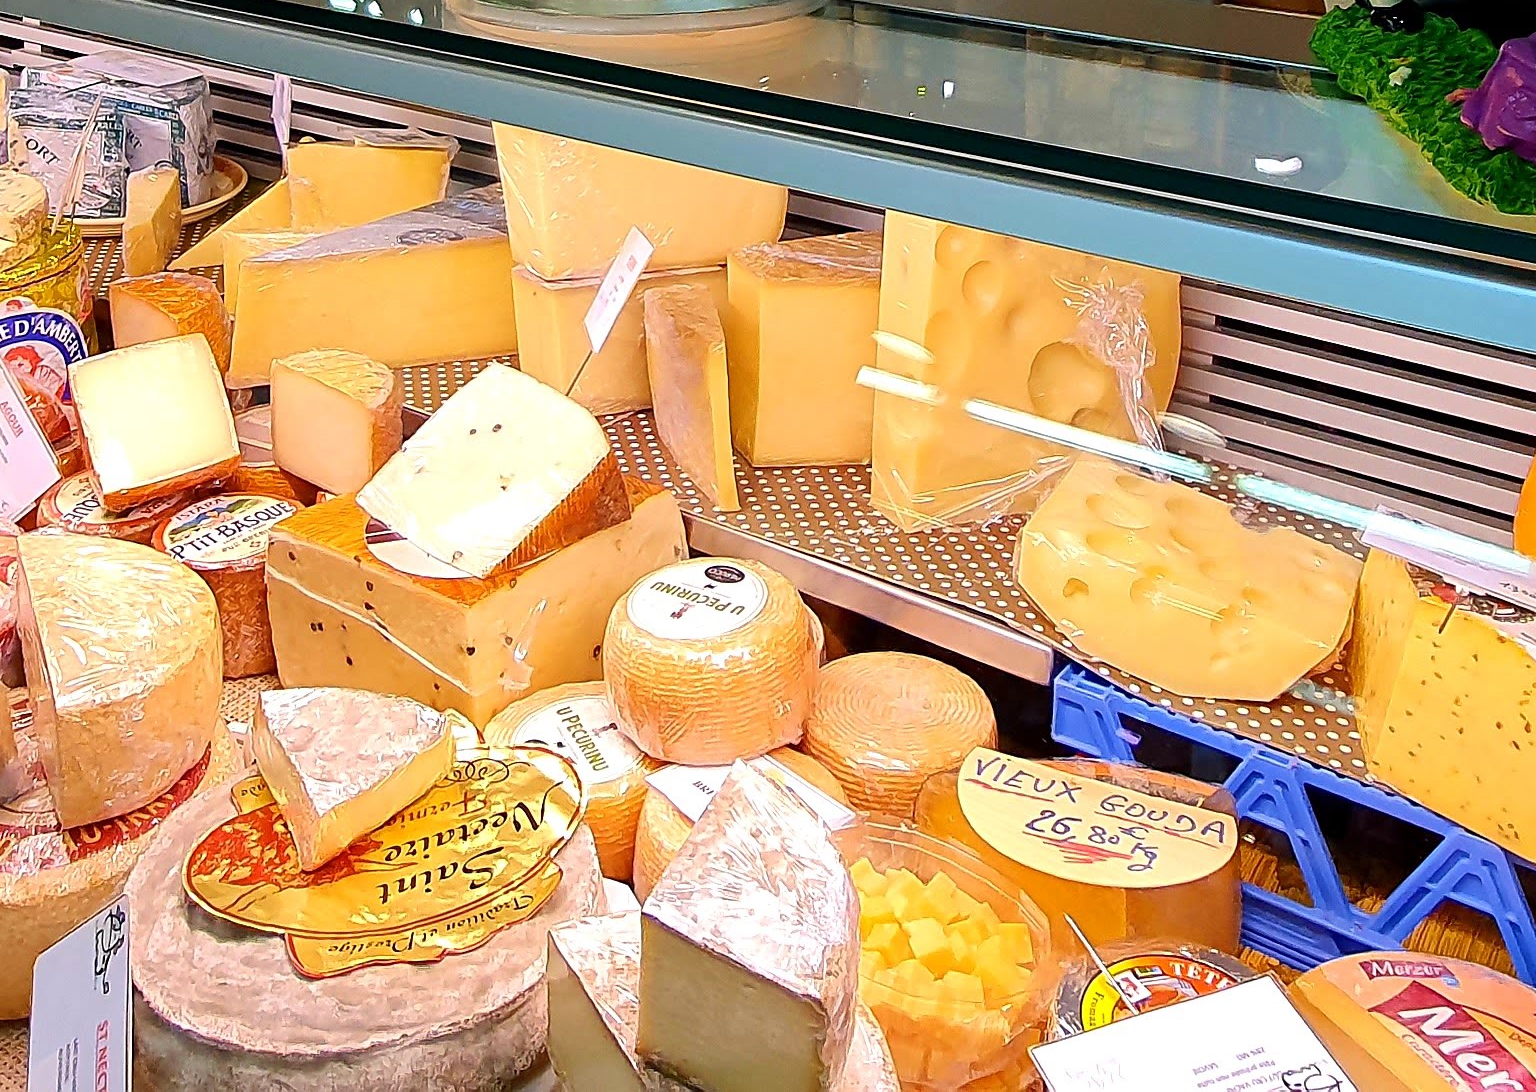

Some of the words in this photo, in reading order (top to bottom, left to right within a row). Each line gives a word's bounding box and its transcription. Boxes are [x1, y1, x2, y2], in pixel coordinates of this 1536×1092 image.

[14, 317, 83, 363] D'AMBERT
[217, 502, 294, 539] BASQUE
[650, 581, 732, 613] PECURINU
[731, 604, 746, 616] U
[556, 706, 572, 717] U
[567, 712, 609, 773] PECURINU
[975, 756, 1082, 804] VIEUX
[1099, 794, 1227, 844] GOUDA
[384, 781, 565, 863] Nectaire
[375, 845, 504, 906] Saint
[445, 894, 536, 934] Tradition
[1370, 960, 1444, 979] Merzer
[97, 1019, 109, 1041] ST
